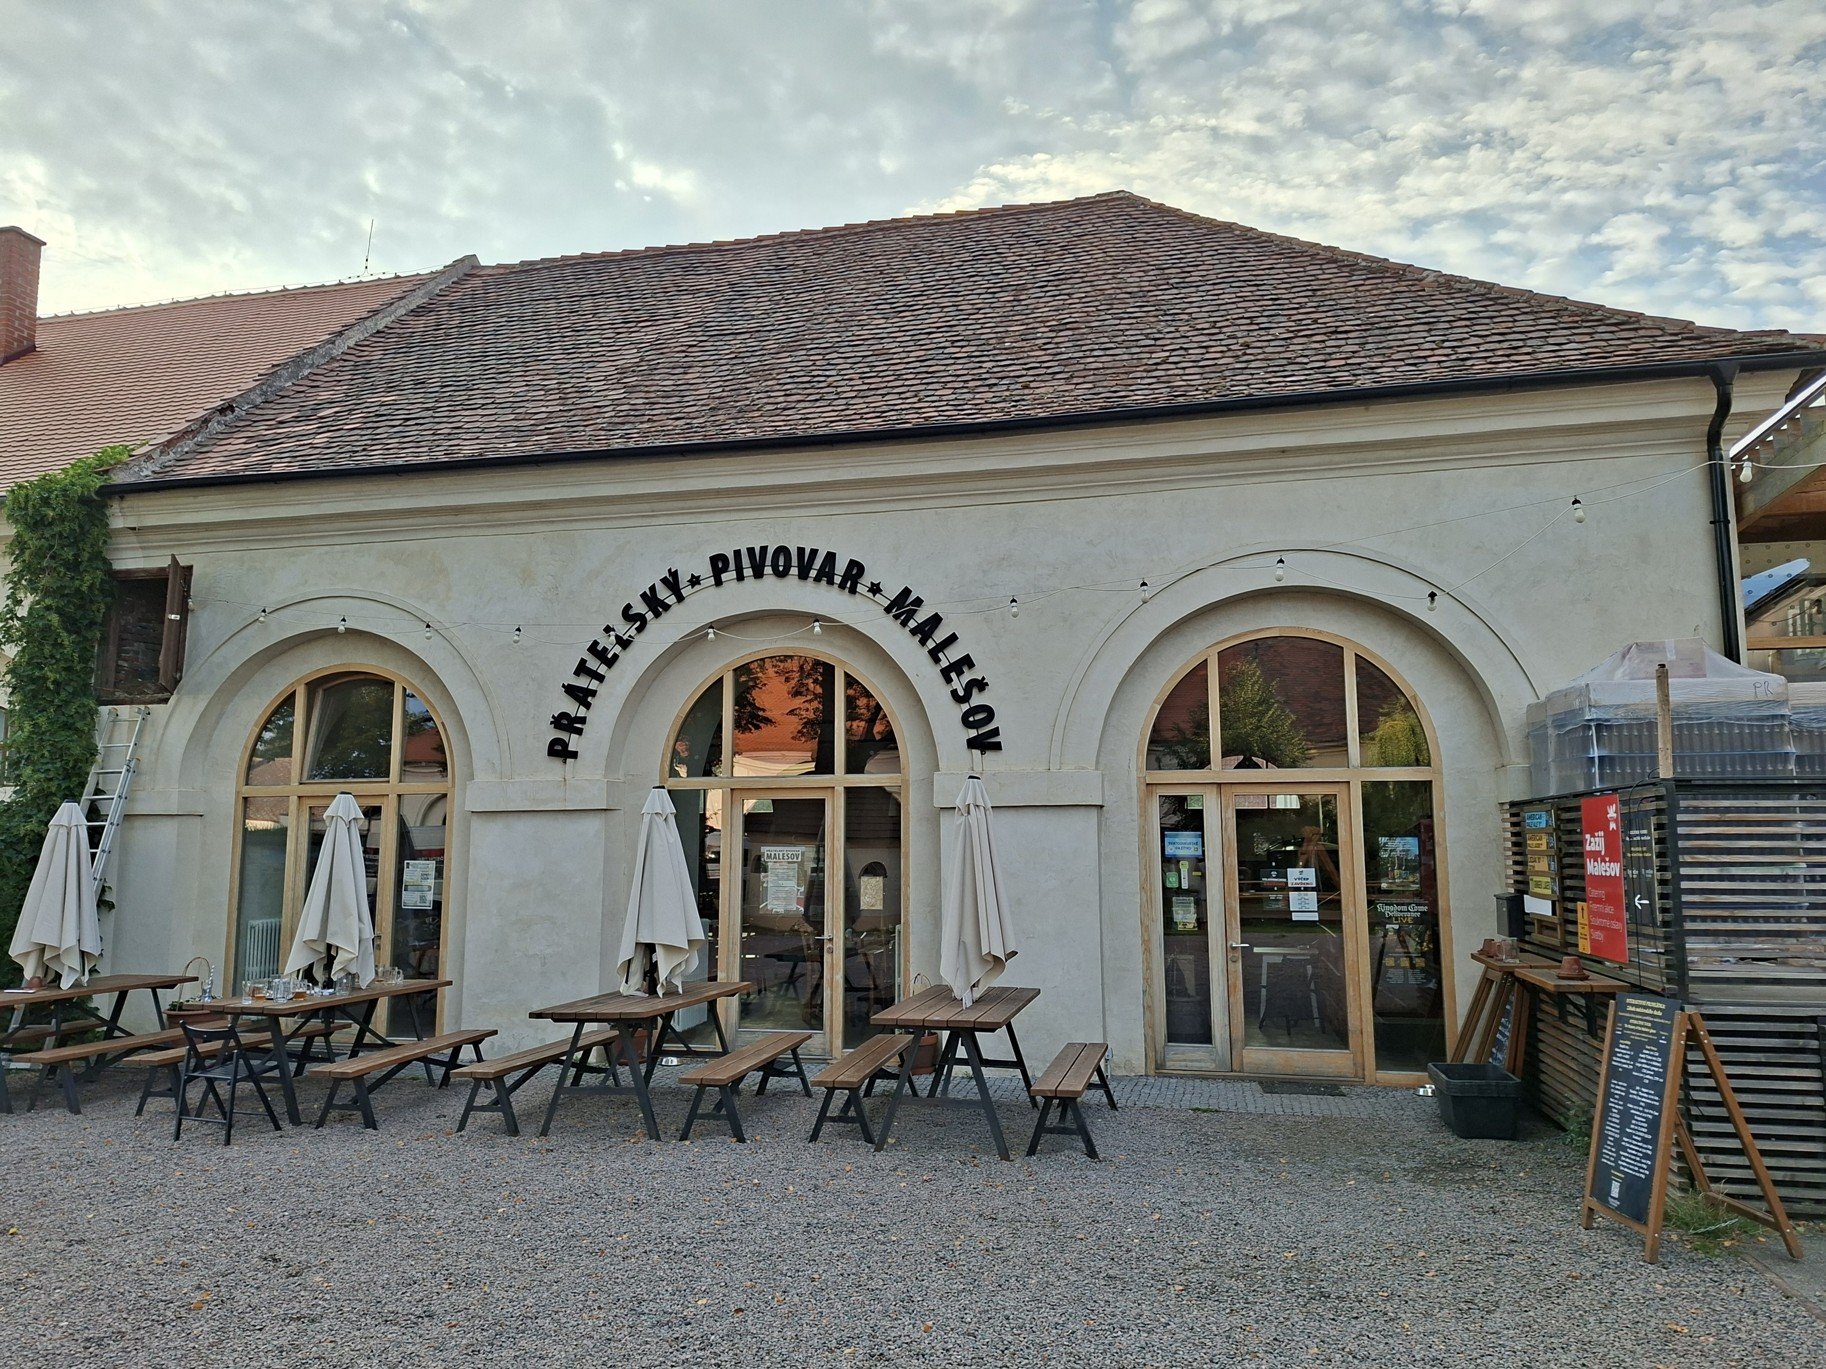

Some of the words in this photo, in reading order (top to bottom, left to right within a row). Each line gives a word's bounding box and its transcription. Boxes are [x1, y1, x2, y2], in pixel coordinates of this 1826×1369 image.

[709, 545, 865, 595] PIVOVAR
[884, 586, 1002, 752] MALEŠOV
[1585, 831, 1605, 855] Zažij
[1587, 857, 1621, 877] Malešov
[1376, 903, 1408, 913] Kingdom
[1408, 903, 1429, 912] Come
